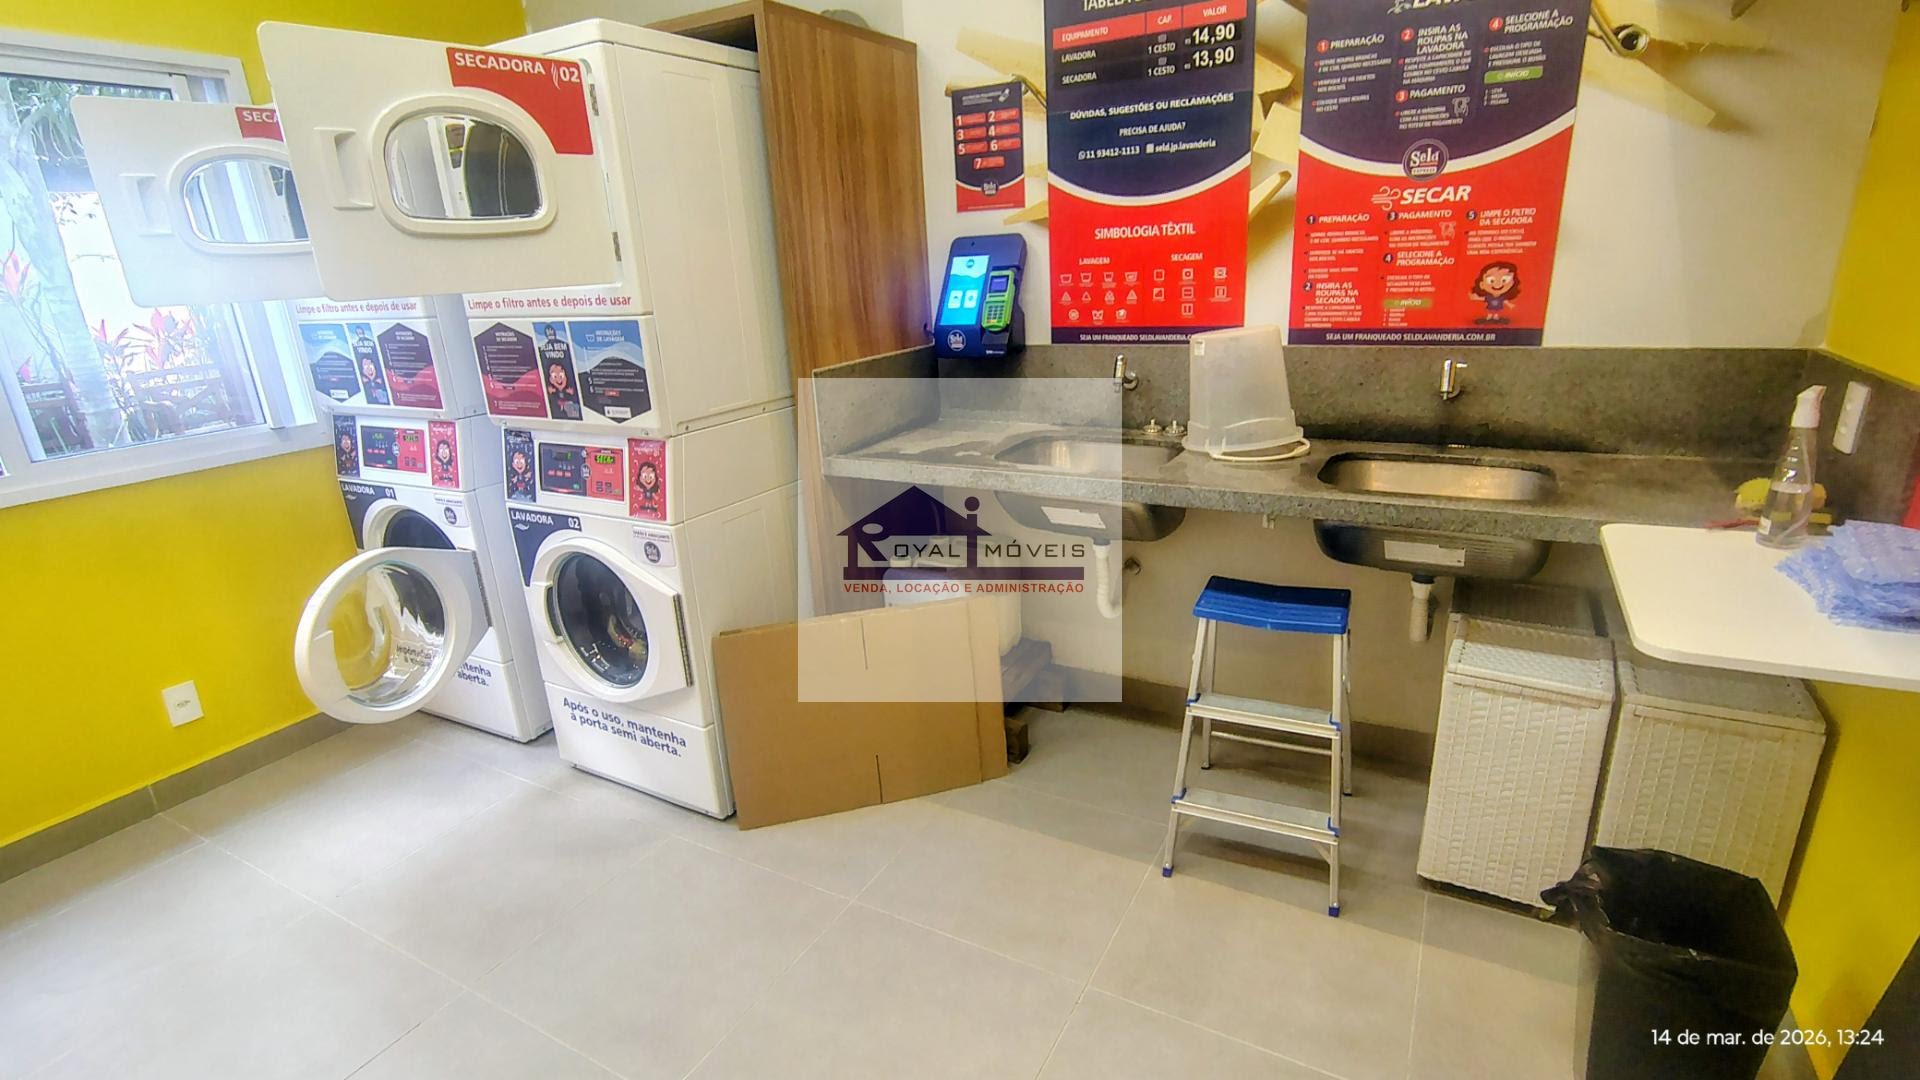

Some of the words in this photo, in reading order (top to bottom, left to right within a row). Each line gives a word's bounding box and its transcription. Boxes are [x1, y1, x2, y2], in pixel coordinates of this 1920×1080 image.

[1203, 5, 1228, 17] VALOR
[1505, 9, 1550, 25] SELECIONE
[1552, 9, 1559, 18] A
[1418, 25, 1447, 37] INSIRA
[1449, 23, 1461, 33] AS
[1504, 16, 1574, 34] PROGRAMAÇÃO
[1062, 27, 1109, 42] EQUIPAMENTO
[1192, 23, 1236, 45] 14,90
[1417, 34, 1453, 46] ROUPAS
[1454, 31, 1469, 42] NA
[1330, 34, 1385, 50] PREPARAÇÃO
[1417, 41, 1465, 55] LAVADORA
[1148, 46, 1152, 55] 1
[1154, 43, 1176, 54] CESTO
[1062, 50, 1097, 63] LAVADORA
[1192, 47, 1235, 68] 13,90
[454, 52, 546, 75] SECADORA
[560, 67, 580, 83] 02
[1148, 69, 1152, 77] 1
[1154, 66, 1176, 76] CESTO
[1062, 72, 1098, 85] SECADORA
[1410, 84, 1466, 99] PAGAMENTO
[1070, 107, 1107, 120] DÚVIDAS,
[1108, 102, 1154, 116] SUGESTÕES
[1156, 101, 1169, 110] OU
[1170, 92, 1234, 109] RECLAMAÇÕES
[956, 115, 963, 126] 1
[988, 111, 996, 122] 2
[956, 129, 964, 140] 3
[988, 125, 996, 137] 4
[1119, 124, 1147, 136] PRECISA
[1149, 125, 1158, 134] DE
[1159, 122, 1186, 133] AJUDA?
[958, 143, 965, 155] 5
[990, 140, 998, 151] 6
[1086, 149, 1095, 159] 11
[1410, 147, 1440, 167] Seld
[975, 158, 981, 170] 7
[1400, 185, 1472, 205] SECAR
[1319, 213, 1370, 224] PREPARAÇÃO
[1399, 209, 1452, 219] PAGAMENTO
[1480, 209, 1501, 218] LIMPE
[1503, 209, 1510, 218] O
[1511, 207, 1537, 217] FILTRO
[1479, 217, 1490, 226] DA
[1492, 215, 1533, 226] SECADORA
[1094, 224, 1160, 240] SIMBOLOGIA
[1161, 221, 1196, 238] TÊXTIL
[1079, 256, 1110, 265] LAVAGEM
[1171, 252, 1203, 261] SECAGEM
[1396, 257, 1455, 267] PROGRAMAÇÃO
[1316, 282, 1340, 290] INSIRA
[1342, 281, 1353, 289] AS
[1315, 289, 1346, 297] ROUPAS
[296, 303, 316, 314] Limpe
[321, 303, 339, 313] filtro
[340, 303, 358, 312] antes
[366, 302, 390, 314] depois
[391, 301, 400, 311] de
[401, 302, 417, 312] usar
[468, 299, 493, 313] Limpe
[495, 301, 501, 309] o
[502, 297, 525, 308] filtro
[526, 298, 551, 308] antes
[561, 295, 593, 310] depois
[594, 295, 608, 306] de
[609, 296, 632, 306] usar
[1102, 333, 1139, 342] FRANQUEADO
[1140, 333, 1192, 341] SELDLAVANDERIA.C
[1326, 333, 1341, 341] SEJA
[1342, 333, 1353, 341] UM
[1354, 333, 1402, 342] FRANQUEADO
[541, 343, 553, 351] SEJA
[553, 342, 567, 351] BEM
[545, 351, 564, 359] VINDO
[341, 483, 376, 495] LAVADORA
[385, 489, 394, 498] 01
[511, 511, 554, 526] LAVADORA
[568, 518, 580, 529] 02
[563, 697, 589, 714] Após
[592, 708, 599, 717] o
[601, 711, 624, 727] uso,
[627, 720, 687, 748] mantenha
[580, 715, 609, 732] porta
[611, 727, 637, 741] semi
[640, 734, 682, 758] aberta.
